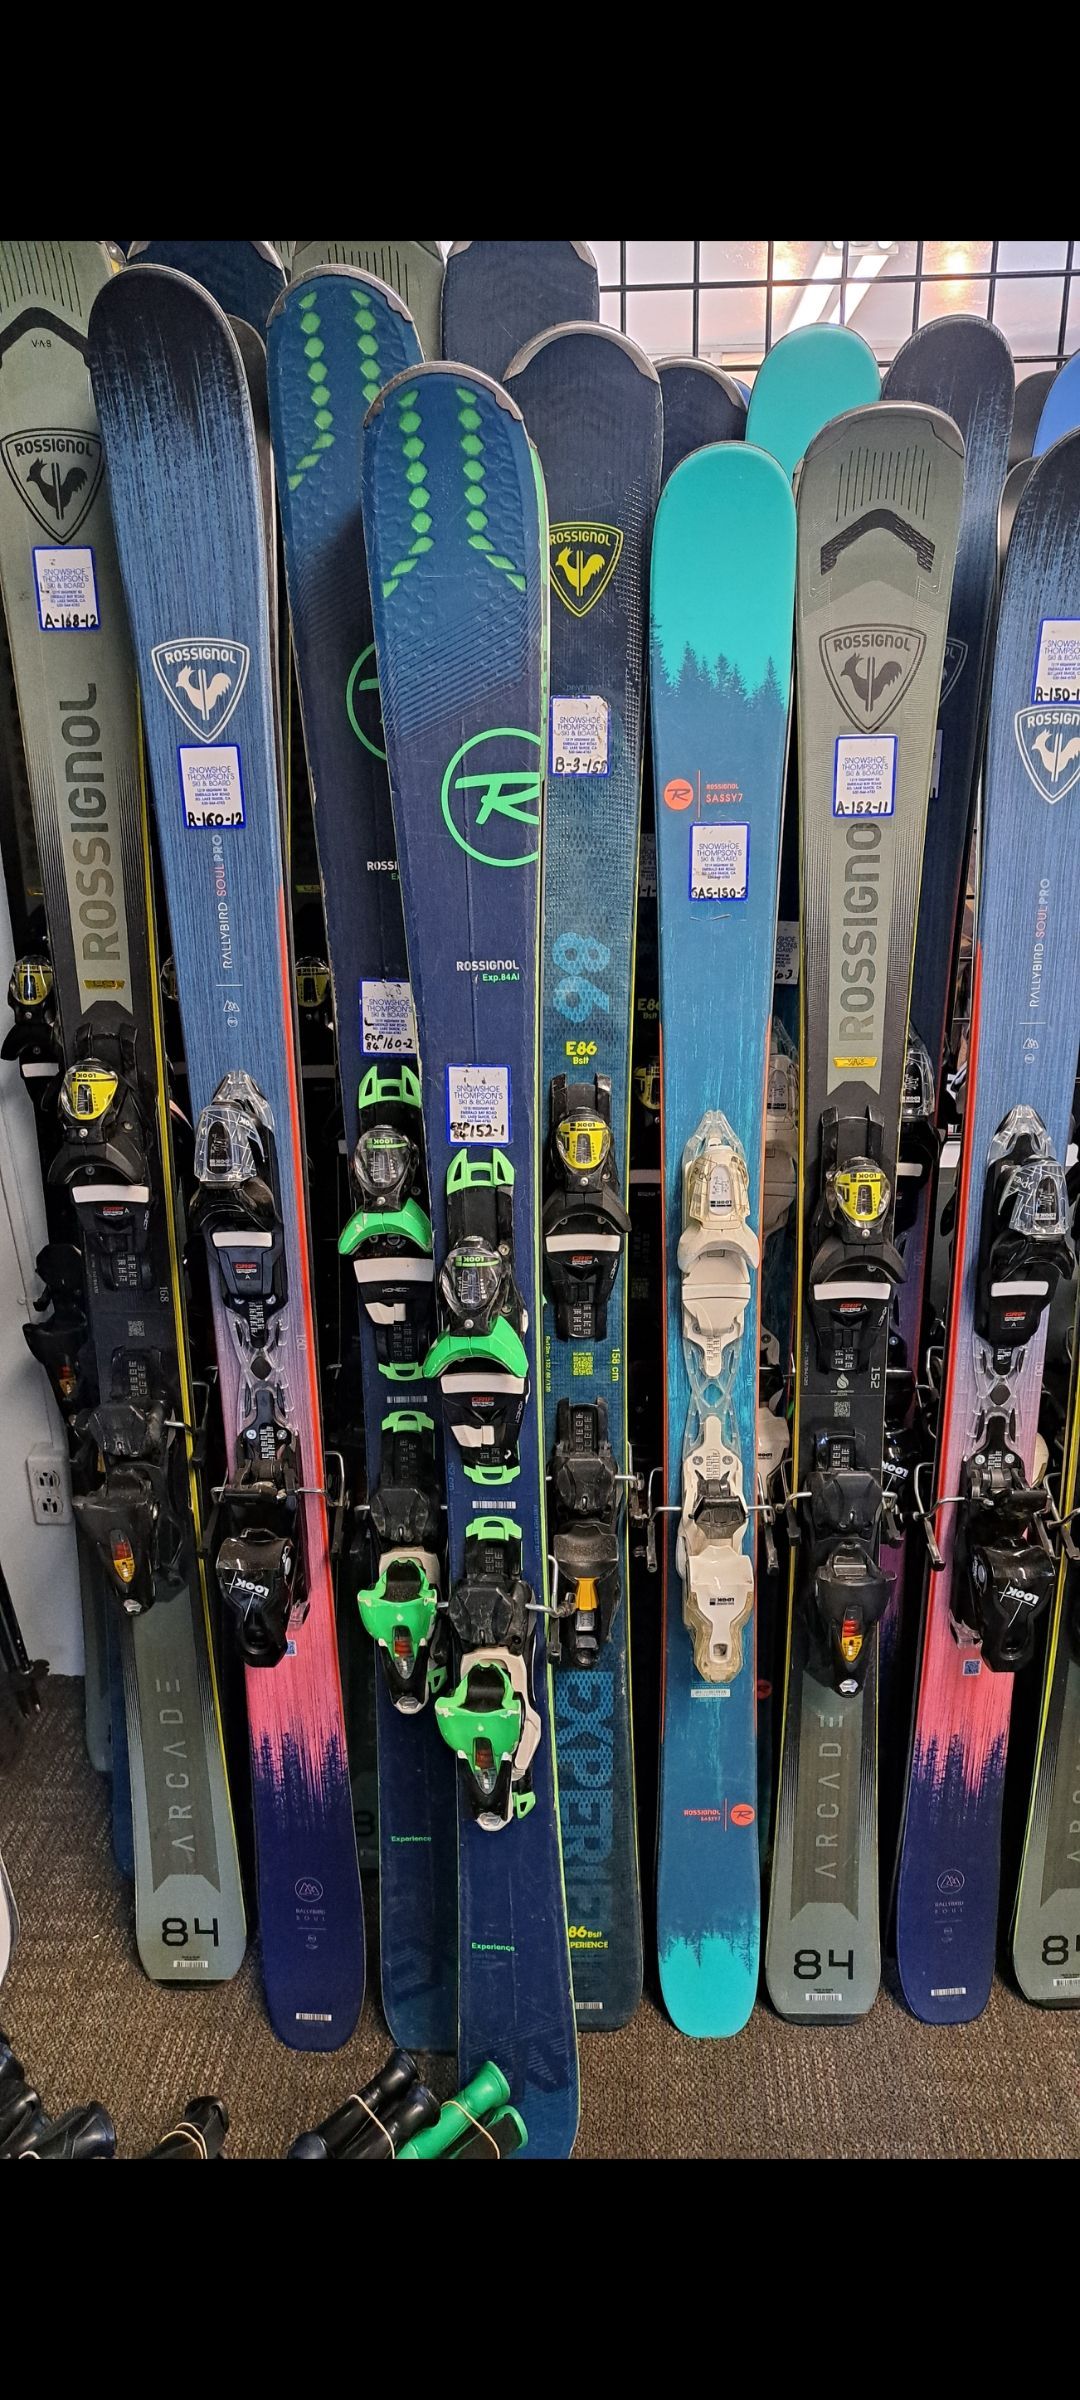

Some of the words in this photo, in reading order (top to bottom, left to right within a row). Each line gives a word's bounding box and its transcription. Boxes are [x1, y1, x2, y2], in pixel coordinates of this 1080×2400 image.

[14, 438, 93, 457] ROSSIGNOL
[549, 530, 611, 546] ROSSIGNOL
[43, 568, 86, 576] SNOWSHOE
[45, 613, 96, 628] A-168-12
[833, 634, 911, 652] ROSSIGNOL
[165, 647, 236, 665] ROSSIGNOL
[559, 716, 600, 724] SNOWSHOE
[1027, 712, 1080, 728] ROSSIGN
[844, 756, 885, 764] SNOWSHOE
[188, 766, 231, 774] SNOWSHOE
[706, 793, 743, 803] SASSY7
[836, 800, 887, 815] A-152-11
[60, 682, 120, 961] ROSSIGNOL
[187, 811, 242, 827] R-160-12
[212, 834, 224, 862] PRO
[367, 861, 399, 871] ROSSI
[215, 863, 227, 896] SOUL
[1039, 878, 1050, 905] PRO
[1035, 905, 1048, 938] SOUL
[218, 902, 232, 969] RALLYBIRD
[839, 822, 882, 1041] ROSSIGNO
[456, 960, 519, 971] ROSSIGNOL
[552, 932, 610, 1024] 86
[1029, 943, 1044, 1008] RALLYBIRD
[383, 1036, 413, 1049] 160-2
[566, 1041, 597, 1056] E86
[456, 1085, 501, 1093] SNOWSHOE
[470, 1124, 504, 1137] 152-1
[159, 1286, 169, 1303] 168
[611, 1347, 620, 1364] 158
[612, 1367, 619, 1382] cm
[871, 1366, 880, 1389] 152
[235, 1577, 270, 1597] LOOK
[1006, 1586, 1039, 1605] LOOK
[155, 1679, 196, 1852] ARCADE
[814, 1713, 844, 1879] ARCADE
[391, 1835, 432, 1843] Experience
[161, 1917, 219, 1947] 84
[471, 1942, 515, 1952] Experience
[570, 1941, 609, 1949] PERIENCE
[1042, 1935, 1080, 1965] 8
[793, 1949, 854, 1980] 84
